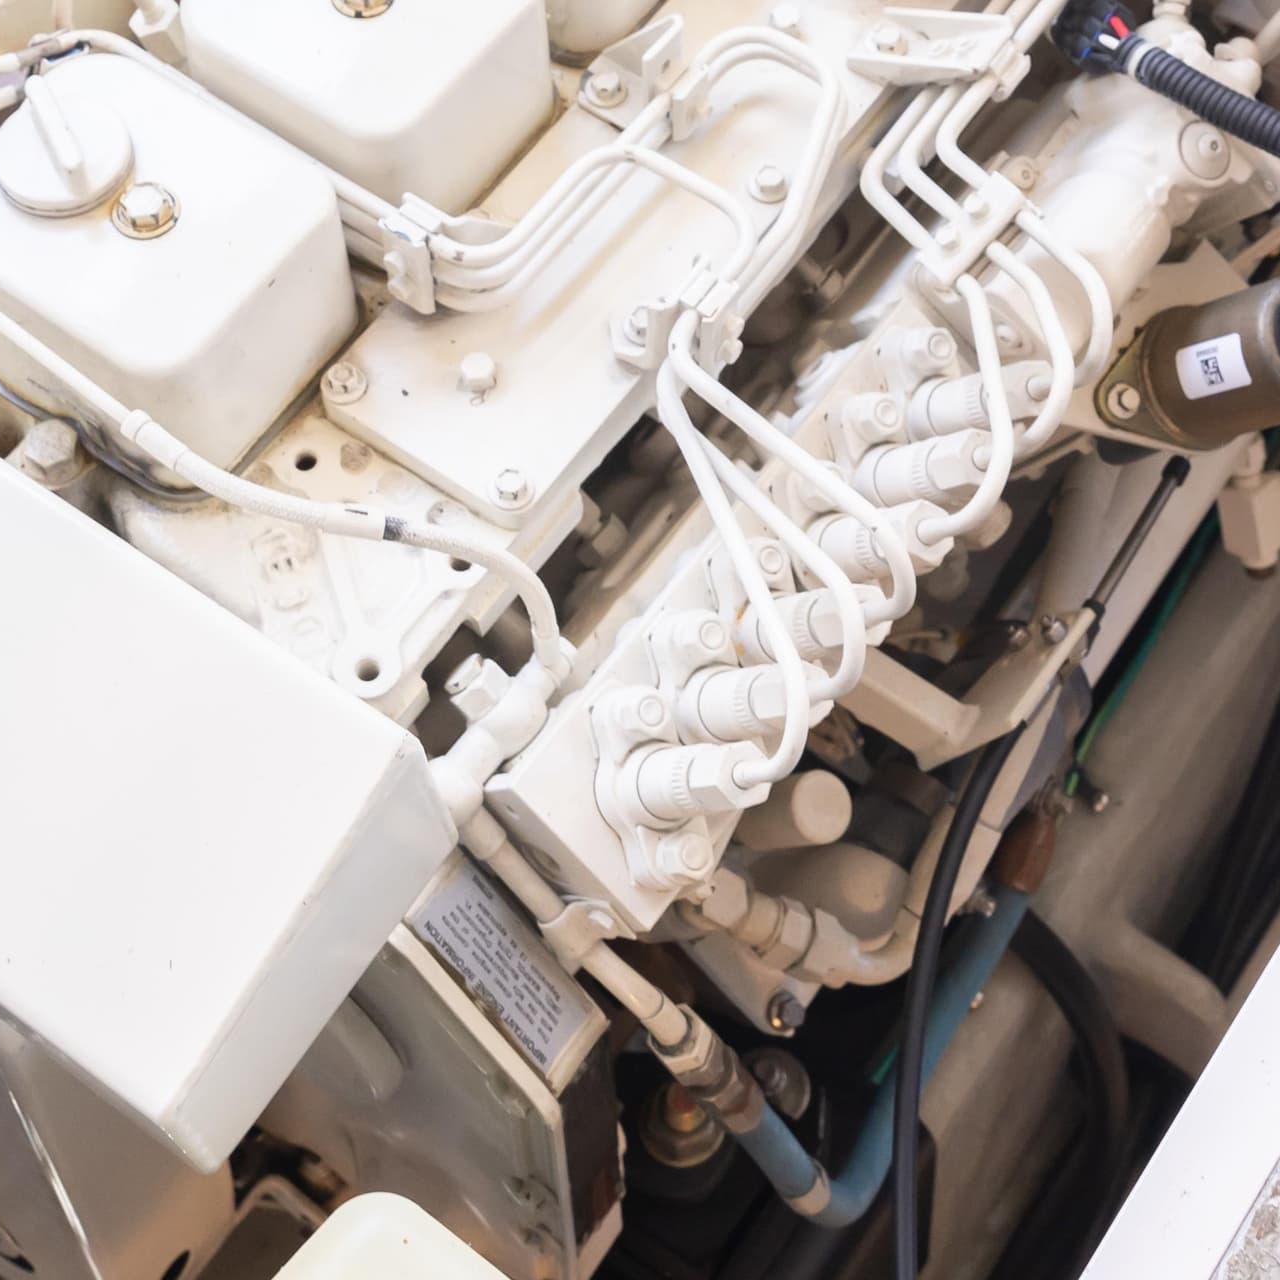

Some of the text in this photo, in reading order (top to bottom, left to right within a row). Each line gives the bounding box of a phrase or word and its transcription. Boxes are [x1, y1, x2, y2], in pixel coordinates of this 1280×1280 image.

[424, 920, 548, 1065] IMPORTANT ENGINE INFORMATION
